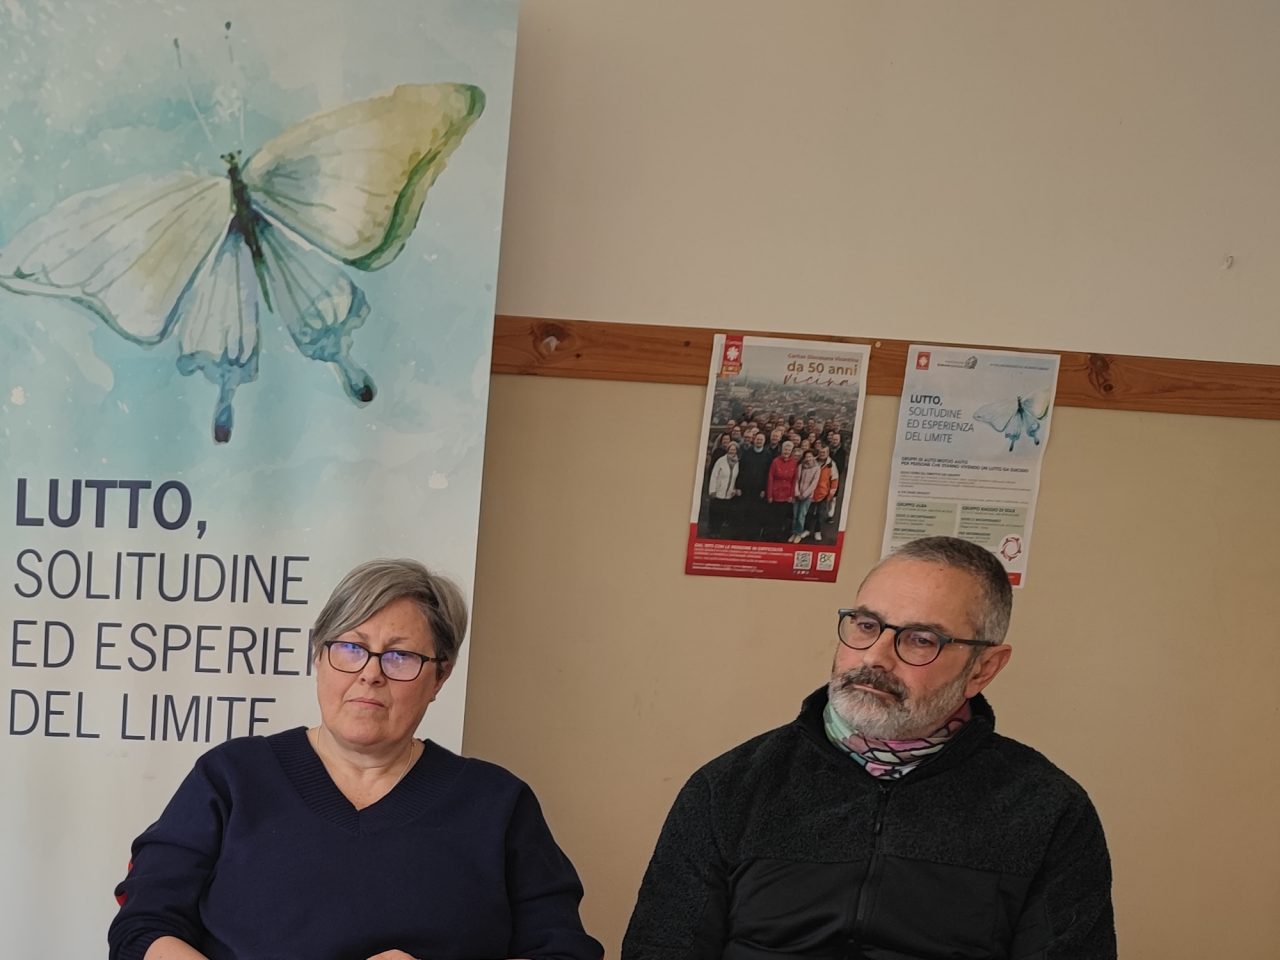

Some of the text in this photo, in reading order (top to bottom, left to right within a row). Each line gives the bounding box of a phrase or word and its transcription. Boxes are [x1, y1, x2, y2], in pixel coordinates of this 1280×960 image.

[787, 361, 858, 376] da 50 anni
[910, 394, 943, 406] LUTTO,
[908, 407, 962, 419] SOLITUDINE
[907, 419, 974, 432] ED ESPERIENZA
[905, 431, 952, 443] DEL LIMITE
[15, 477, 207, 539] LUTTO,
[14, 548, 310, 605] SOLITUDINE
[11, 619, 314, 676] ED ESPERIE
[9, 689, 276, 743] DEL LIMITE
